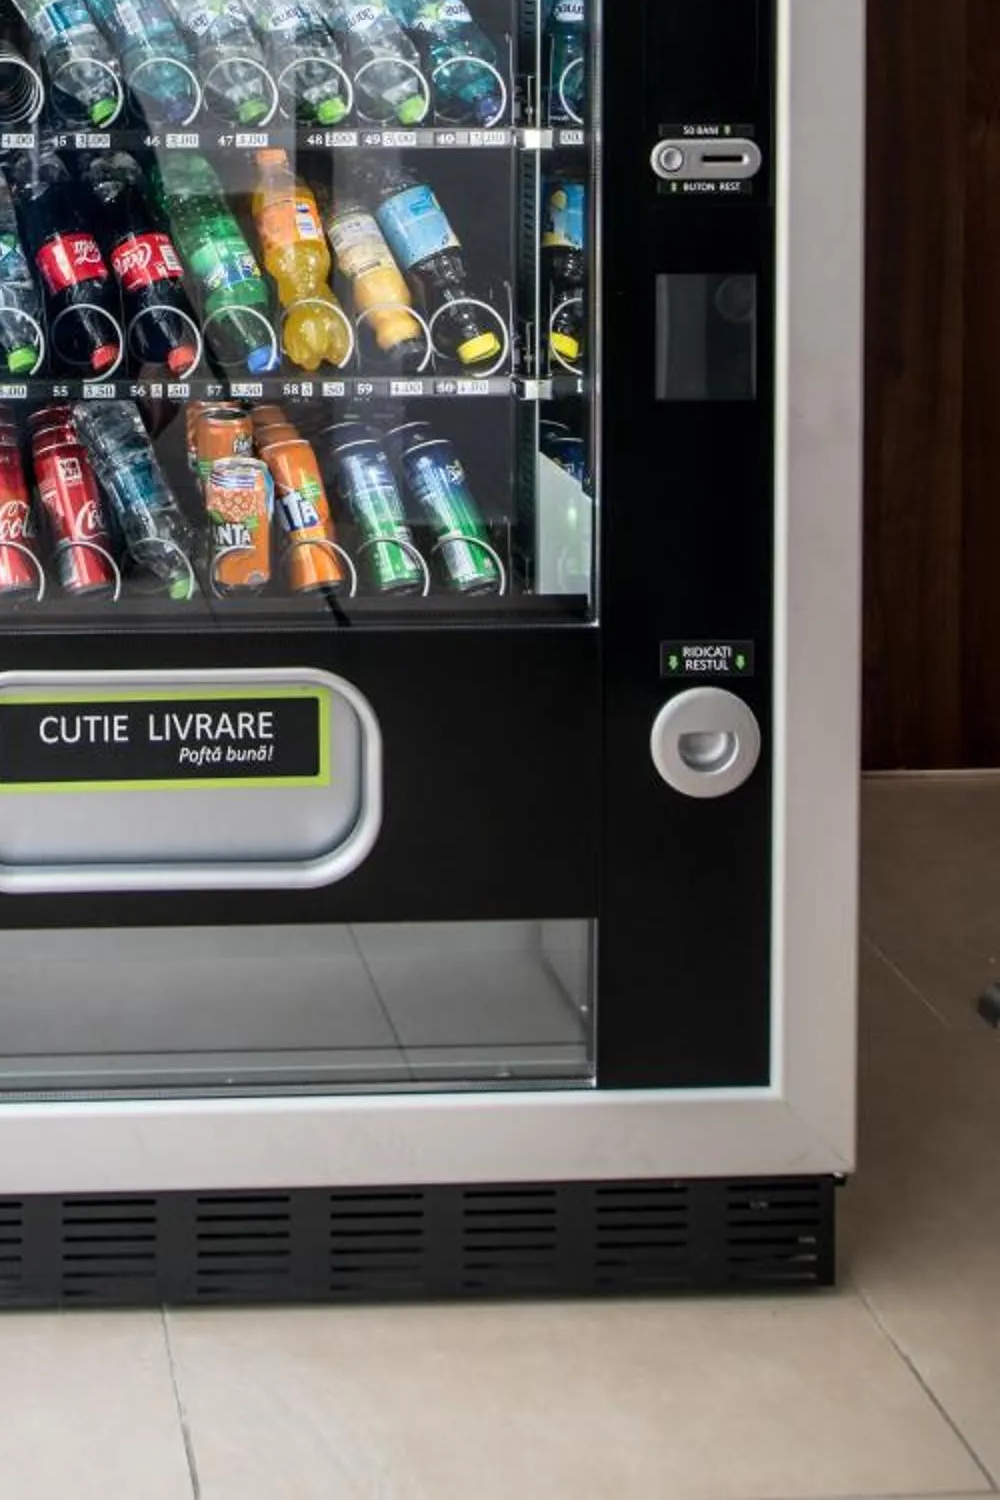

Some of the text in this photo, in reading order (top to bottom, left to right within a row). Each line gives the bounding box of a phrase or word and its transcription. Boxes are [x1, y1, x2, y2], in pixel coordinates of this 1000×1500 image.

[685, 659, 729, 670] RESTUL
[39, 711, 274, 744] CUTIE LIVRARE
[225, 744, 274, 764] bună!
